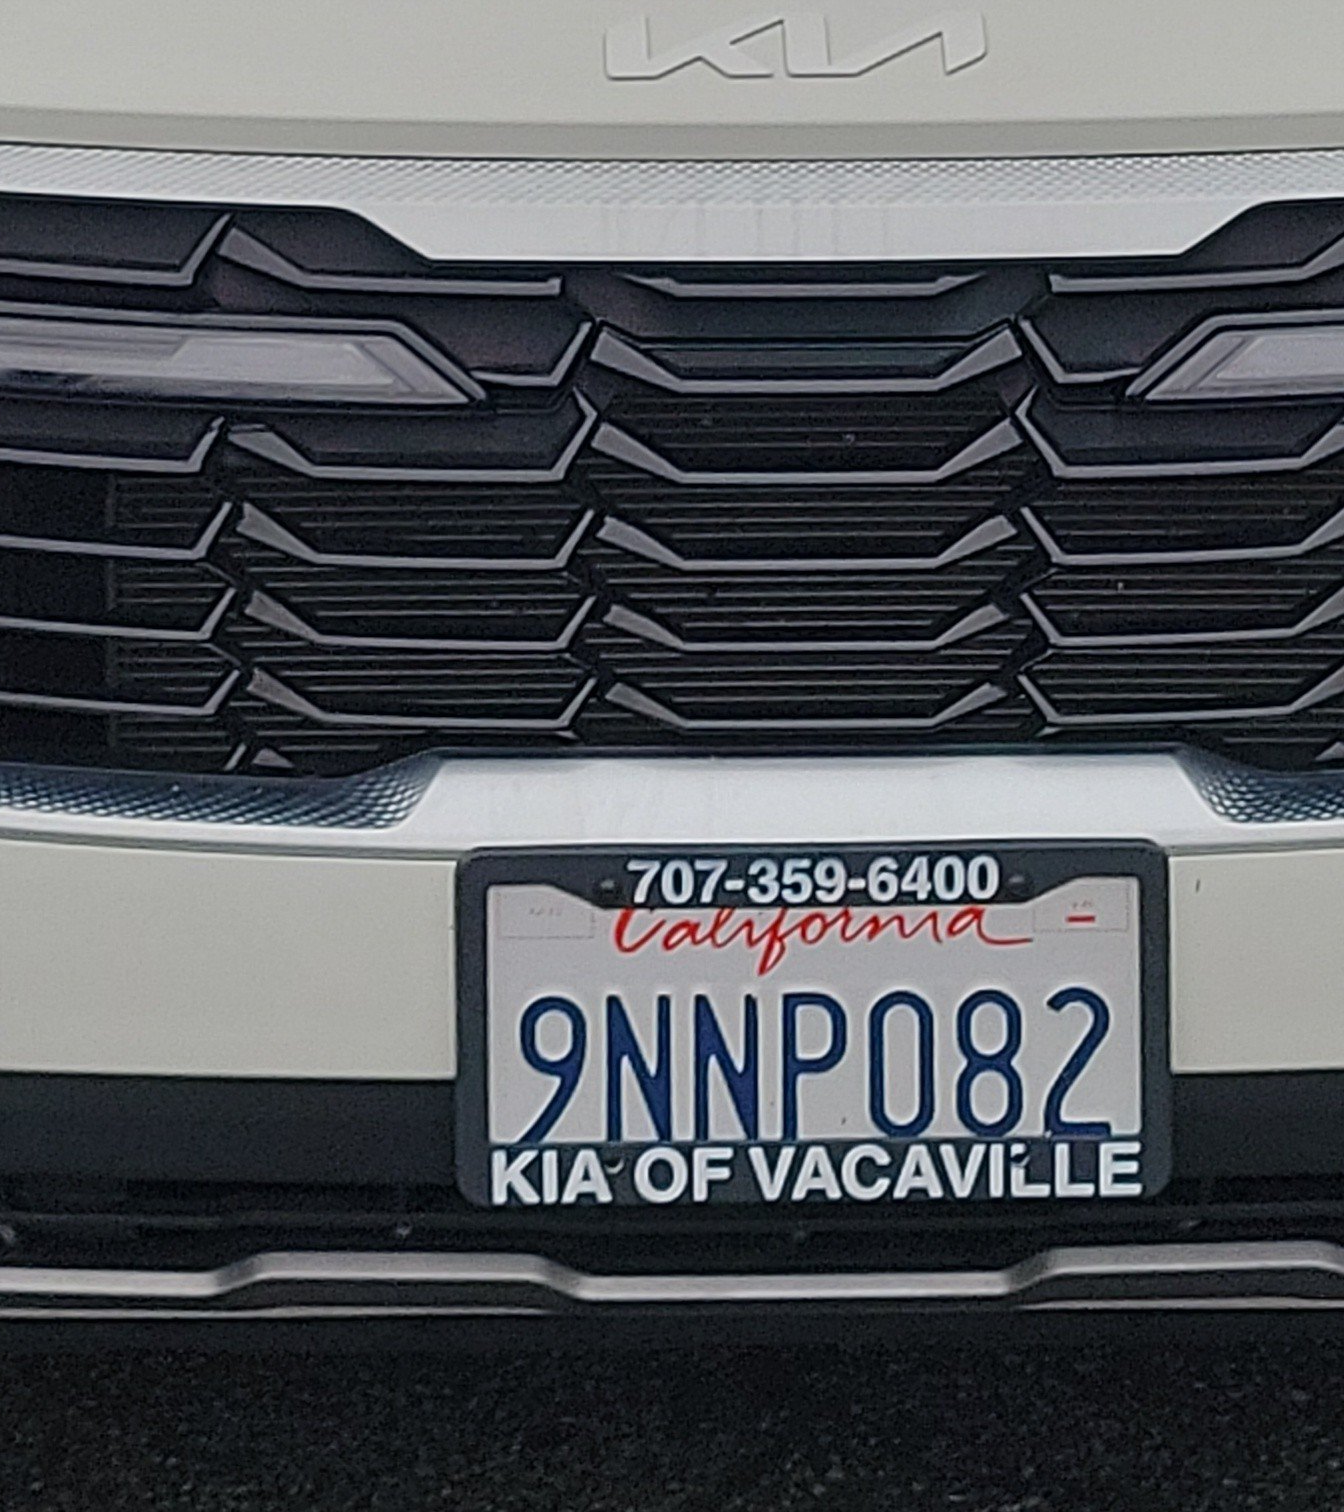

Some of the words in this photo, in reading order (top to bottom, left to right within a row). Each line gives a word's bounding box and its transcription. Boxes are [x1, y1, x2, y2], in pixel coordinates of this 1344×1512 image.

[626, 854, 1001, 905] 707-359-6400
[614, 904, 1034, 977] California
[518, 987, 1112, 1144] 9NNP082
[490, 1149, 613, 1207] KIA
[633, 1145, 734, 1203] OF
[747, 1141, 1144, 1202] VACAVILLE
